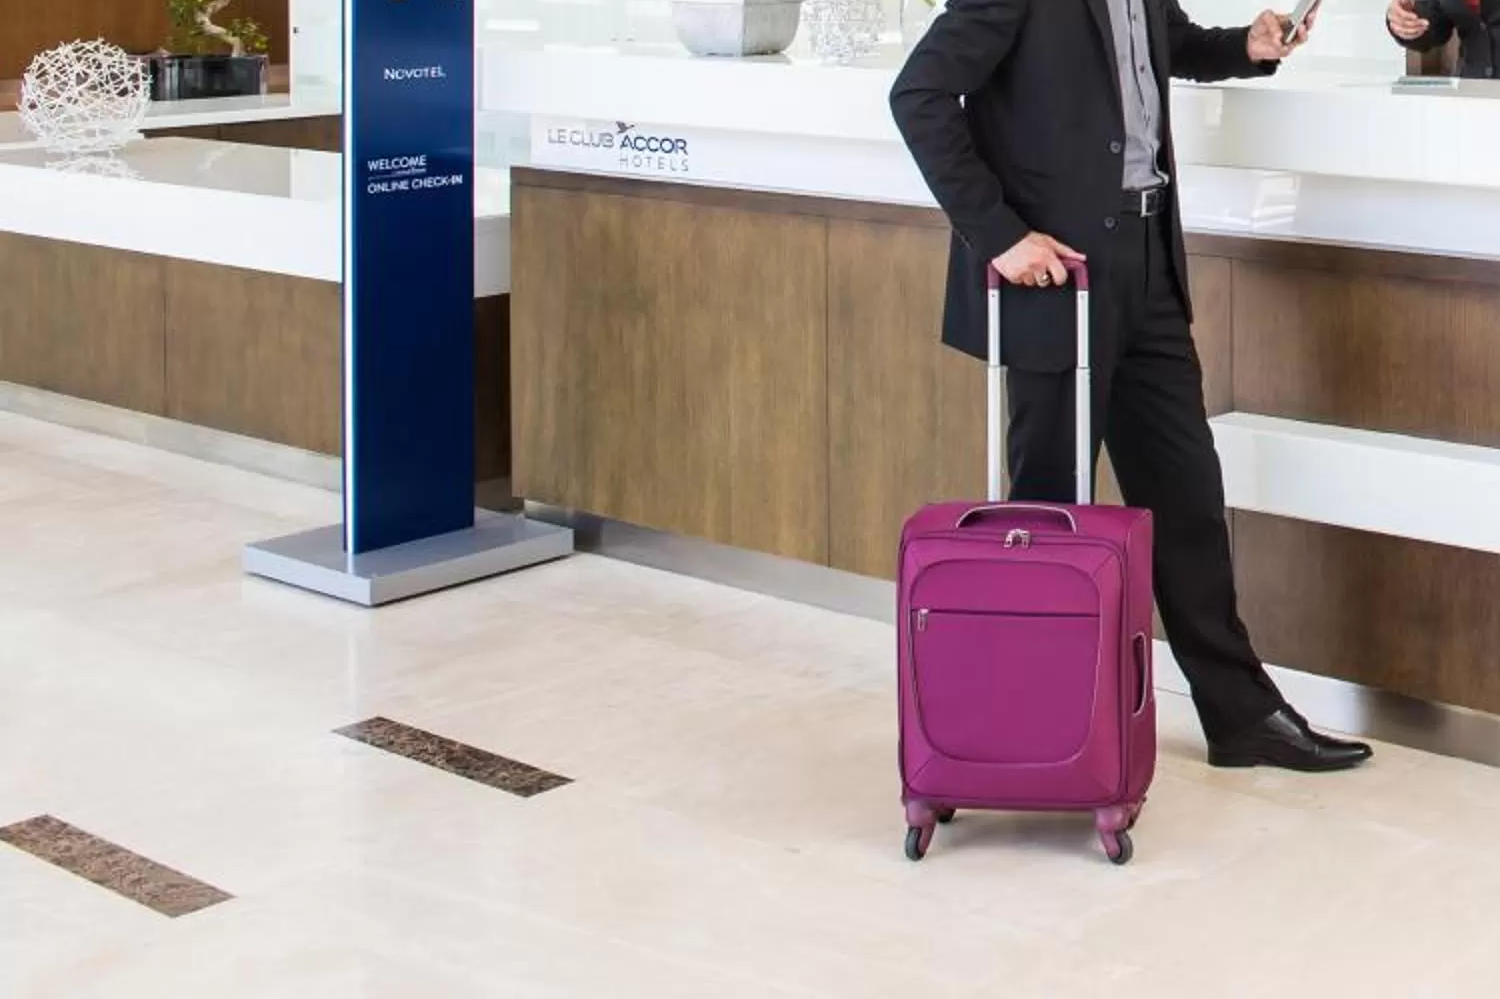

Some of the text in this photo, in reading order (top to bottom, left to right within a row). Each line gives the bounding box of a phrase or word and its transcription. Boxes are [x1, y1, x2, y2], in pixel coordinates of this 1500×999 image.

[384, 66, 447, 80] NOVOTEL
[547, 129, 688, 155] LE CLUB ACCOR
[367, 155, 427, 171] WELCOME
[619, 156, 689, 172] HOTELS
[367, 174, 463, 194] ONLINE CHECK-IN
